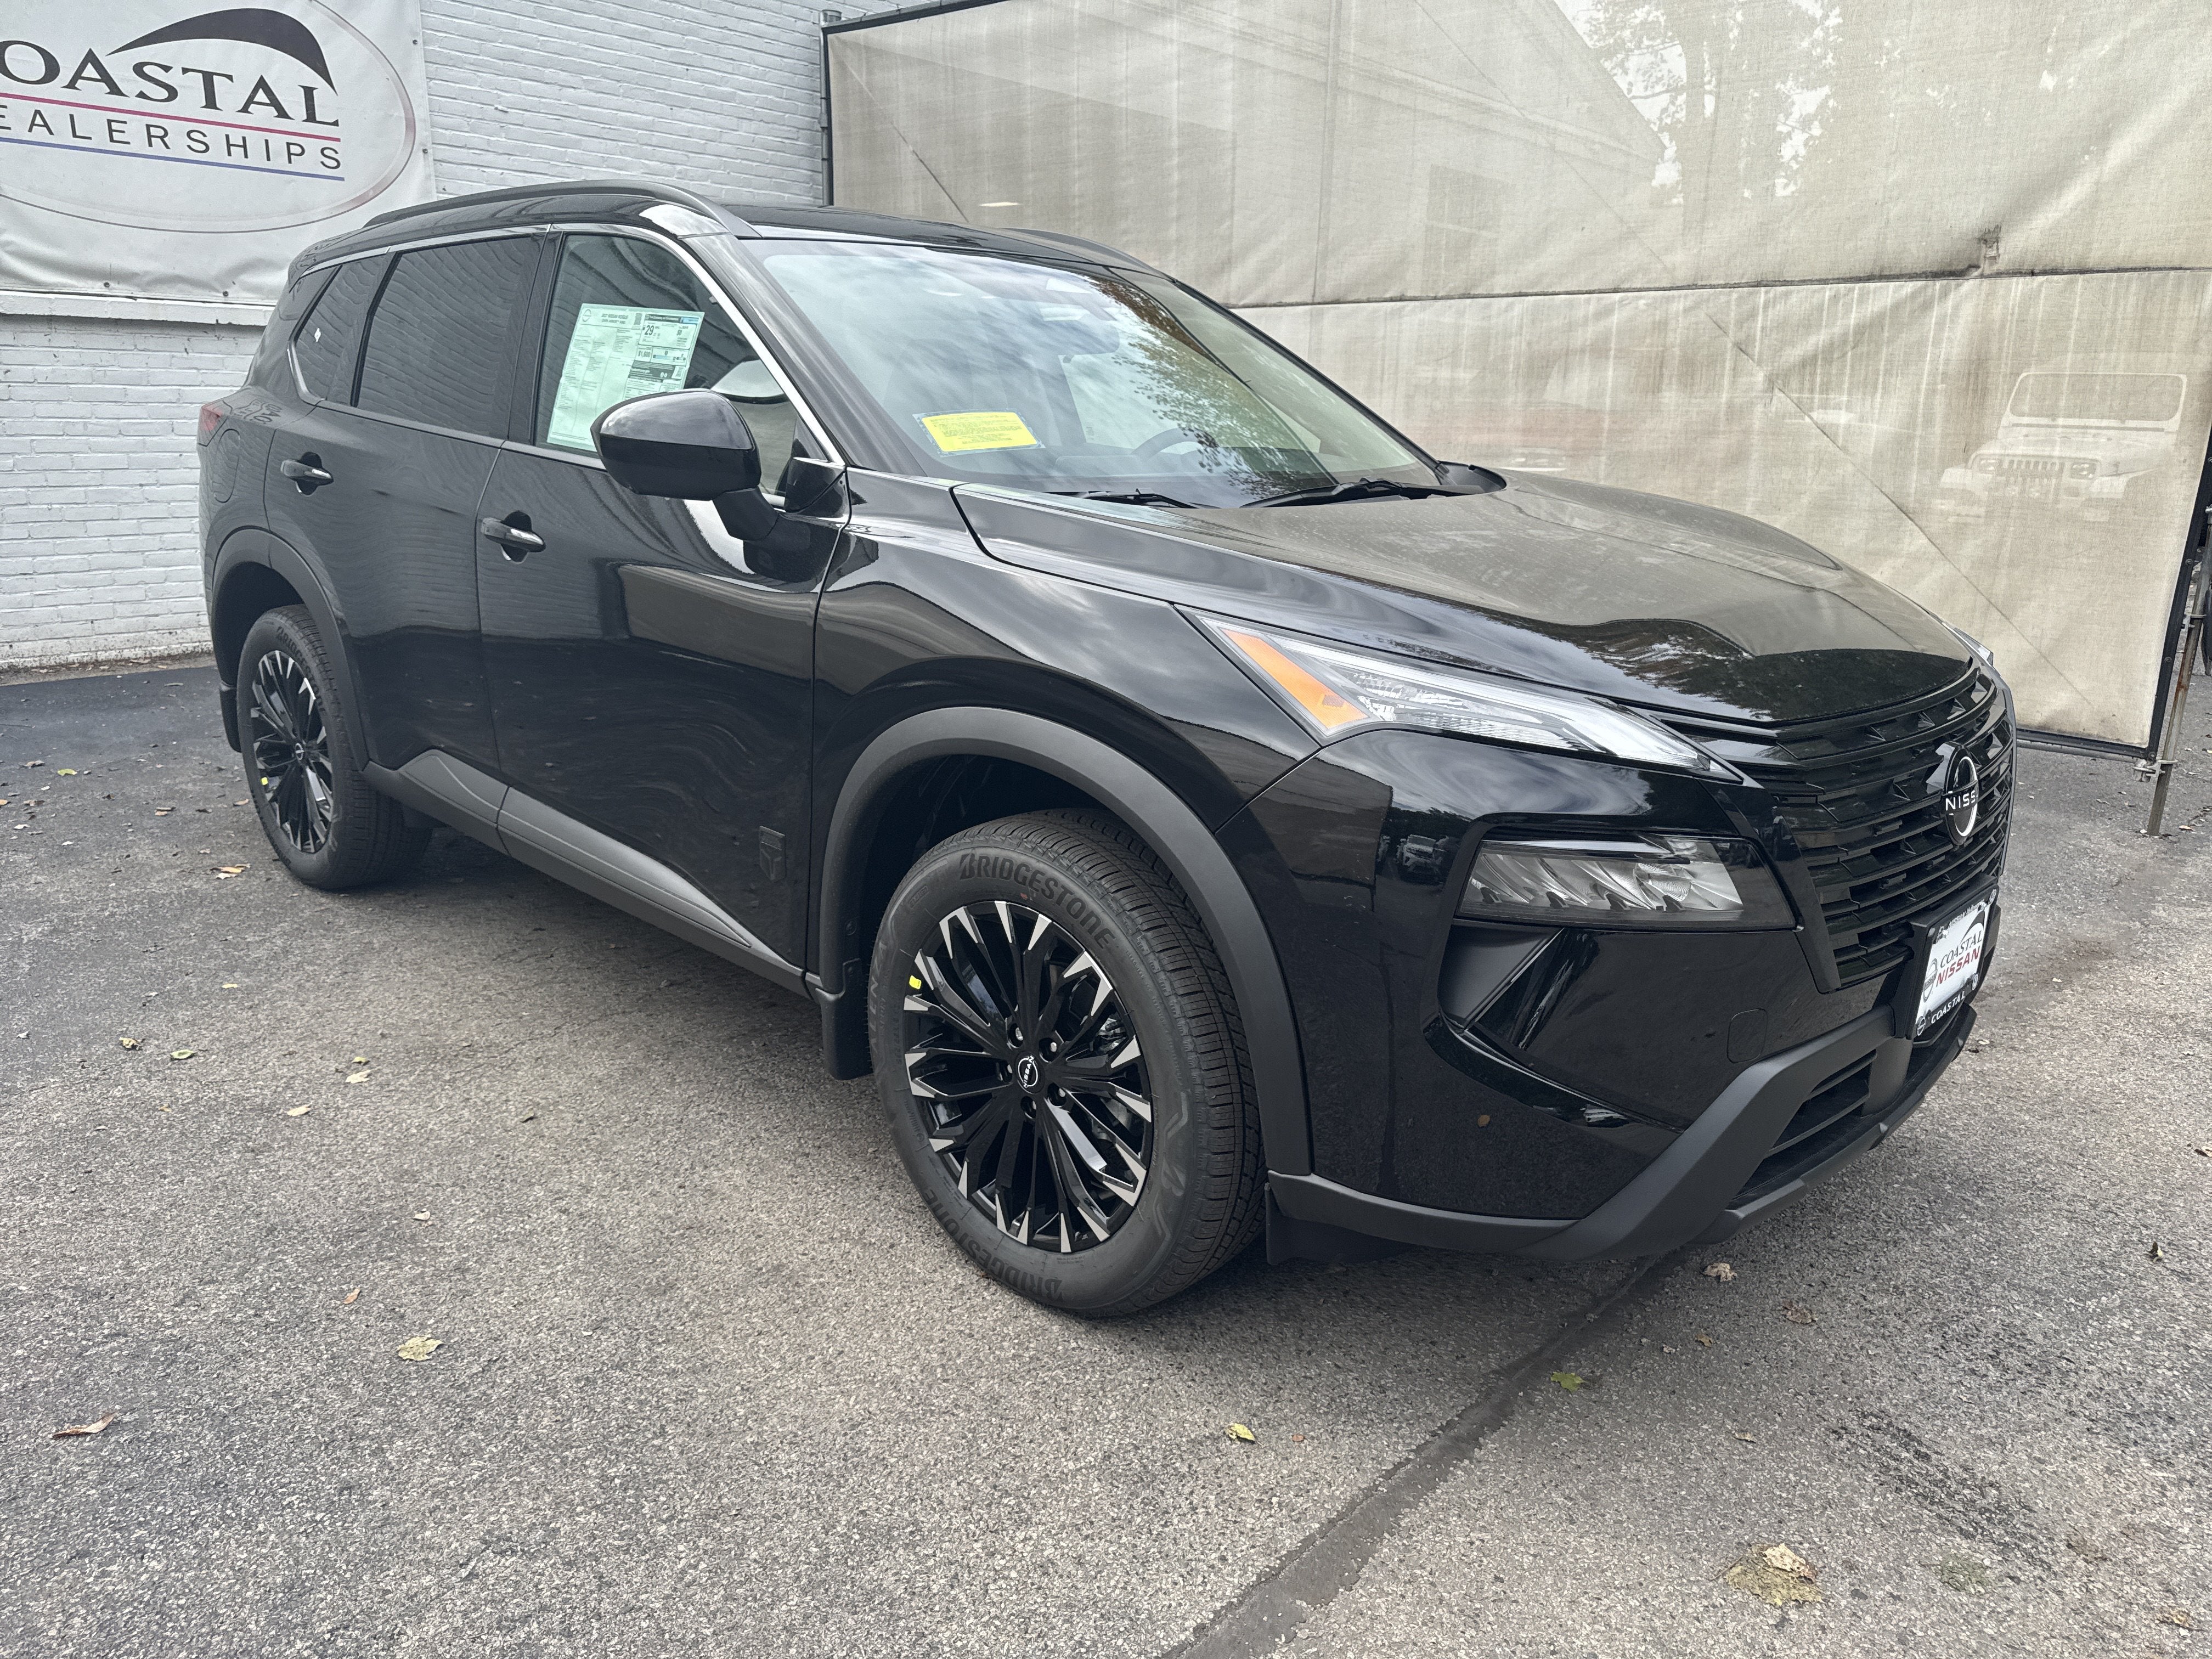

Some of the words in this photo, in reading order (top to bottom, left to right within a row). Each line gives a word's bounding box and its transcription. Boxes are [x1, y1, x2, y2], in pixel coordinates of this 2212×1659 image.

[645, 325, 654, 336] 29
[1945, 789, 1978, 811] NISS
[960, 852, 1116, 949] BRIDGESTONE
[1940, 930, 1982, 968] COASTAL
[1936, 945, 1980, 988] NISSAN
[1931, 990, 1966, 1024] COASTAL
[1023, 1055, 1035, 1088] NISSAN
